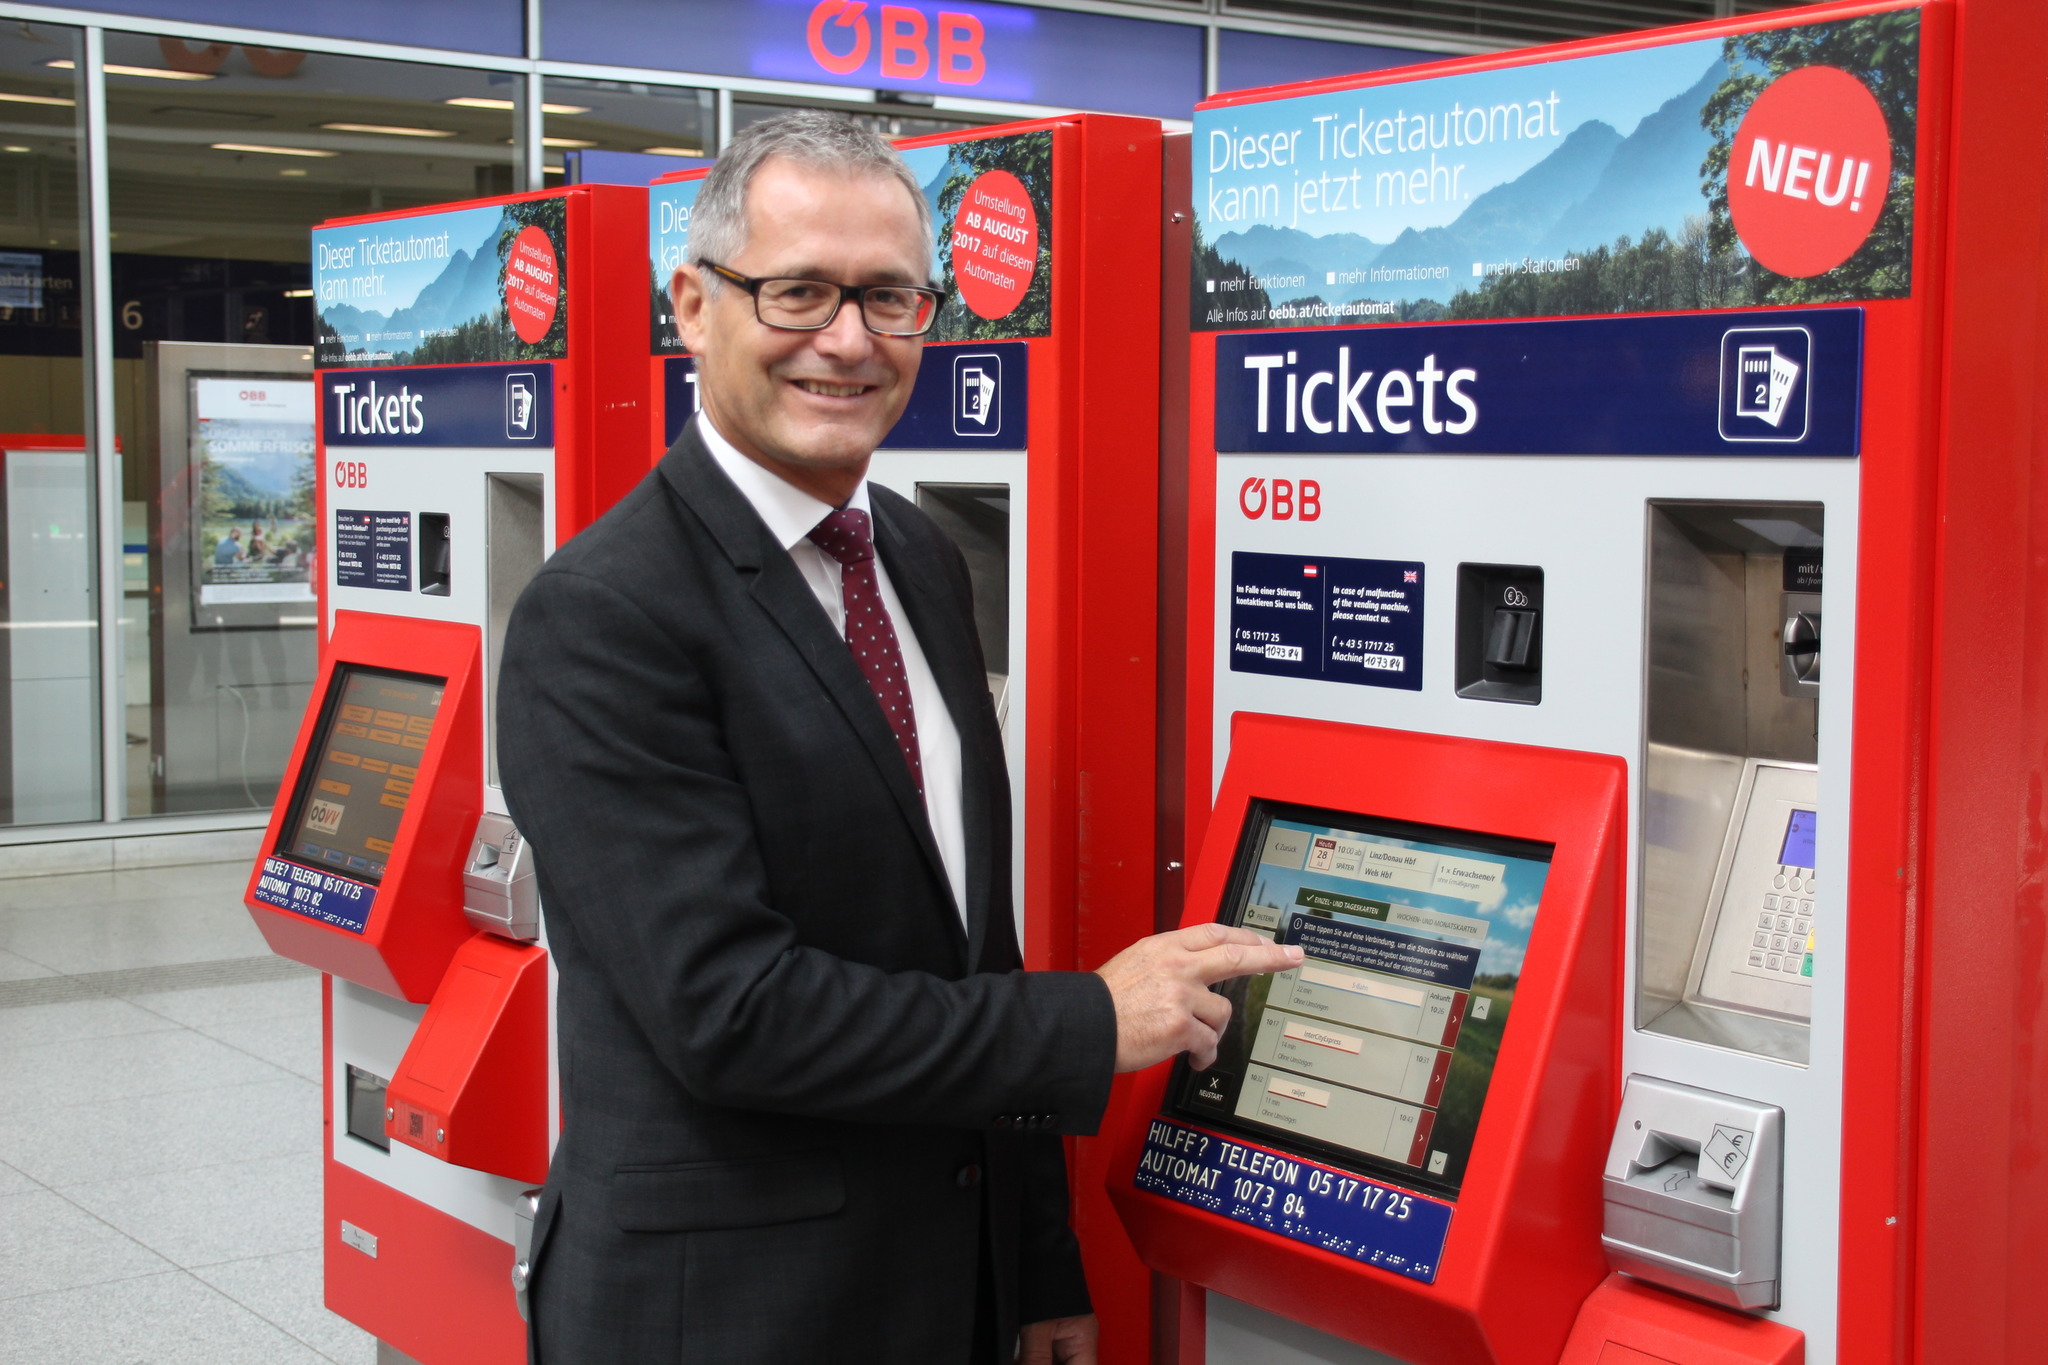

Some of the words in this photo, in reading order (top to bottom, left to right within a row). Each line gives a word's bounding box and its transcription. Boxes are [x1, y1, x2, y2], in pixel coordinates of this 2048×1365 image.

[807, 0, 986, 86] ÖBB
[1209, 126, 1302, 174] Dieser
[1312, 89, 1561, 163] Ticketautomat
[1744, 137, 1870, 213] NEU!
[1208, 176, 1279, 224] kann
[1290, 166, 1362, 230] jetzt
[1374, 157, 1470, 208] mehr.
[974, 189, 1027, 224] Umstellung
[965, 211, 982, 230] AB
[983, 217, 1029, 246] AUGUST
[319, 240, 355, 272] Dieser
[358, 230, 451, 268] Ticketautomat
[519, 241, 552, 268] Umstellung
[953, 231, 981, 253] 2017
[982, 242, 999, 261] auf
[999, 246, 1034, 274] diesem
[514, 258, 525, 272] AB
[525, 263, 554, 286] AUGUST
[1485, 257, 1516, 276] mehr
[1521, 256, 1581, 275] Stationen
[963, 259, 1016, 292] Automaten
[1219, 275, 1246, 293] mehr
[1248, 272, 1306, 291] Funktionen
[1337, 268, 1366, 286] mehr
[1369, 263, 1450, 284] Informationen
[319, 272, 348, 302] kann
[352, 267, 387, 299] mehr.
[507, 273, 525, 291] 2017
[524, 283, 535, 297] auf
[535, 286, 557, 307] diesem
[123, 301, 143, 330] 6
[513, 296, 546, 321] Automaten
[1206, 308, 1224, 324] Alle
[1225, 307, 1248, 323] Infos
[1250, 306, 1266, 322] auf
[1268, 300, 1395, 321] oebb.at/ticketautomat
[673, 336, 686, 347] Info
[1244, 346, 1478, 435] Tickets
[334, 380, 424, 435] Tickets
[335, 460, 368, 489] ÖBB
[1239, 476, 1322, 522] ÖBB
[1236, 585, 1244, 593] Im
[1245, 585, 1260, 594] Falle
[1260, 586, 1276, 595] einer
[1276, 587, 1301, 600] Störung
[1332, 586, 1340, 594] In
[1340, 587, 1356, 596] case
[1356, 587, 1365, 598] of
[1365, 588, 1405, 599] malfunction
[1236, 596, 1274, 608] kontaktieren
[1274, 599, 1284, 608] Sie
[1284, 601, 1296, 610] uns
[1297, 600, 1314, 611] bitte.
[1332, 598, 1341, 609] of
[1341, 599, 1352, 608] the
[1353, 600, 1380, 612] vending
[1380, 603, 1410, 613] machine,
[1332, 610, 1354, 621] please
[1354, 612, 1380, 623] contact
[1380, 615, 1390, 623] us.
[1241, 629, 1251, 640] 05
[1270, 633, 1280, 642] 25
[1235, 643, 1265, 655] Automat
[1266, 646, 1286, 658] 1073
[1287, 648, 1299, 660] 84
[1345, 639, 1355, 649] 43
[1356, 640, 1363, 649] 5
[1383, 642, 1394, 652] 25
[1331, 651, 1363, 663] Machine
[1364, 655, 1388, 669] 1073
[1279, 843, 1297, 853] Zurück
[1317, 839, 1334, 848] Heute
[1338, 845, 1354, 855] 10:00
[1316, 849, 1328, 860] 28
[1369, 850, 1404, 864] Linz/Donau
[1404, 856, 1417, 866] Hbf
[1335, 861, 1355, 872] SPÄTER
[1364, 867, 1379, 878] Wels
[1380, 870, 1393, 880] Hbf
[1452, 867, 1496, 882] Erwachsene/r
[264, 858, 289, 877] HILFE?
[291, 866, 323, 888] TELEFON
[324, 876, 334, 891] 05
[350, 885, 363, 900] 25
[258, 876, 292, 896] AUTOMAT
[293, 885, 311, 903] 1073
[312, 892, 323, 907] 82
[1314, 896, 1332, 906] EINZEL-
[1332, 900, 1343, 908] UND
[1344, 902, 1379, 915] TAGESKARTEN
[1785, 901, 1791, 909] 2
[1803, 904, 1809, 912] 3
[1256, 913, 1275, 923] FILTERN
[1396, 912, 1421, 924] WOCHEN-
[1421, 917, 1434, 926] UND
[1434, 920, 1478, 934] MONATSKARTEN
[1763, 917, 1769, 925] 4
[1303, 922, 1316, 932] Bitte
[1316, 924, 1333, 936] tippen
[1334, 928, 1342, 937] Sie
[1342, 929, 1352, 938] auf
[1352, 932, 1365, 941] eine
[1365, 934, 1396, 949] Verbindung,
[1407, 942, 1417, 952] die
[1417, 945, 1438, 956] Strecke
[1446, 951, 1469, 962] wählen!
[1758, 936, 1764, 944] 7
[1775, 939, 1781, 947] 8
[1793, 942, 1799, 950] 9
[1770, 957, 1776, 966] 0
[1429, 992, 1451, 1003] Ankunft
[1303, 1030, 1342, 1046] InterCityExpress
[1198, 1089, 1224, 1101] NEUSTART
[1291, 1088, 1306, 1097] railjet
[1140, 1149, 1222, 1191] AUTOMAT
[1233, 1176, 1276, 1208] 1073
[1282, 1193, 1306, 1219] 84
[1219, 1142, 1300, 1187] TELEFON
[1308, 1169, 1334, 1196] 05
[1385, 1192, 1413, 1220] 25
